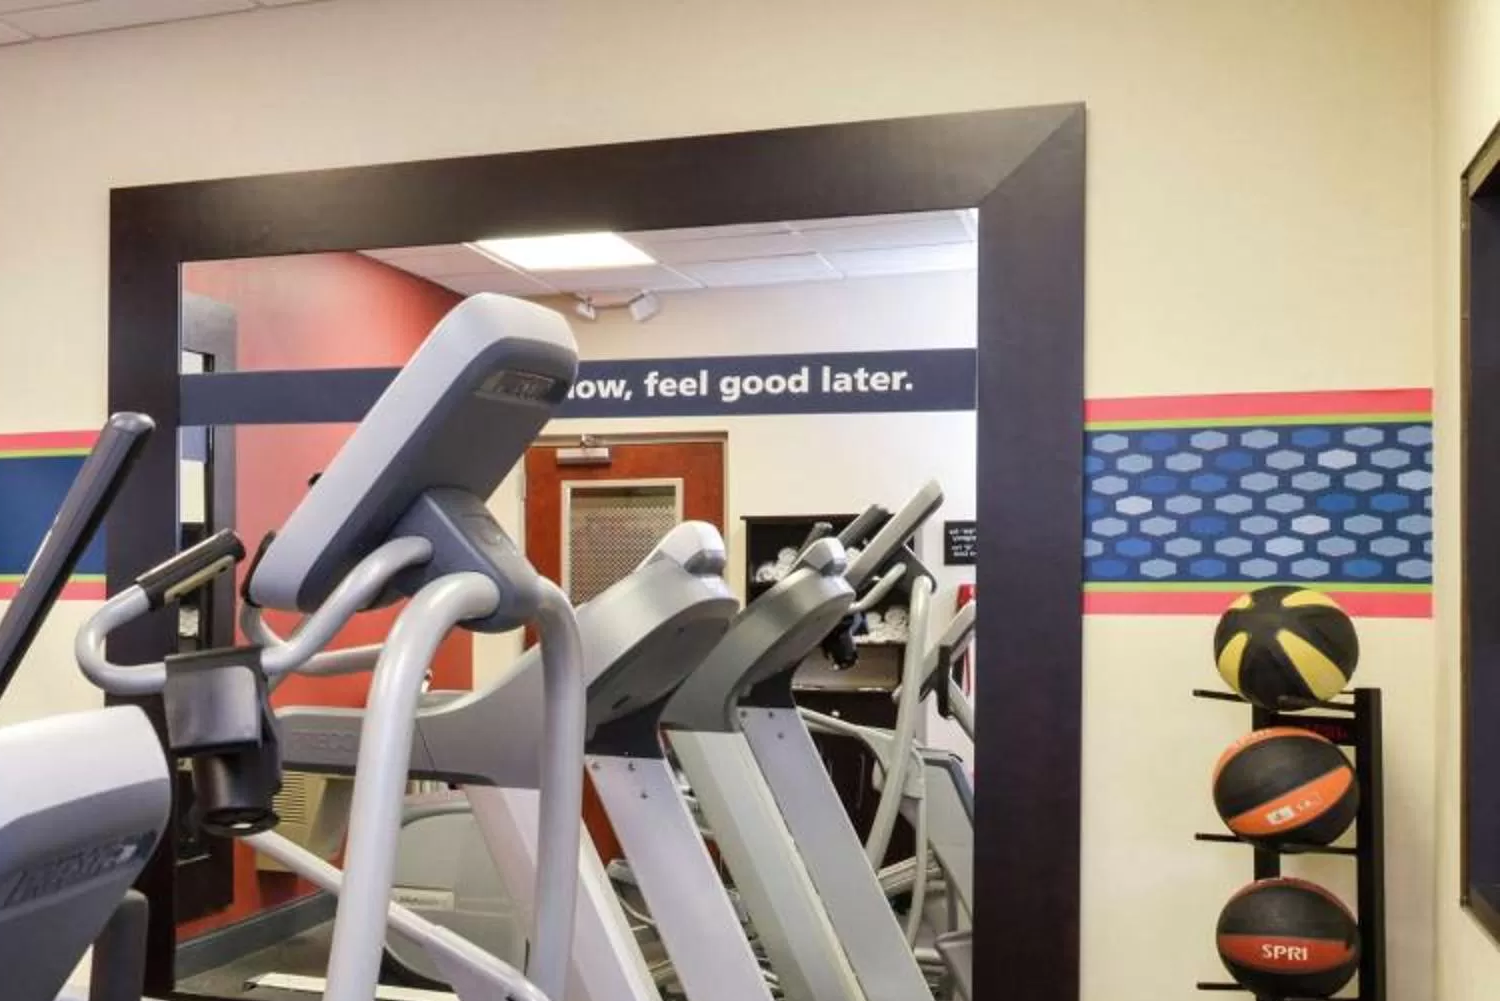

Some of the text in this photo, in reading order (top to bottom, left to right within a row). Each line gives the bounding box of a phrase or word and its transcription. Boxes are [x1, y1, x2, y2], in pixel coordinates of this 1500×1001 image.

[644, 369, 708, 397] feel
[719, 366, 809, 402] good
[822, 366, 913, 393] later.
[1261, 943, 1308, 961] SPRI
